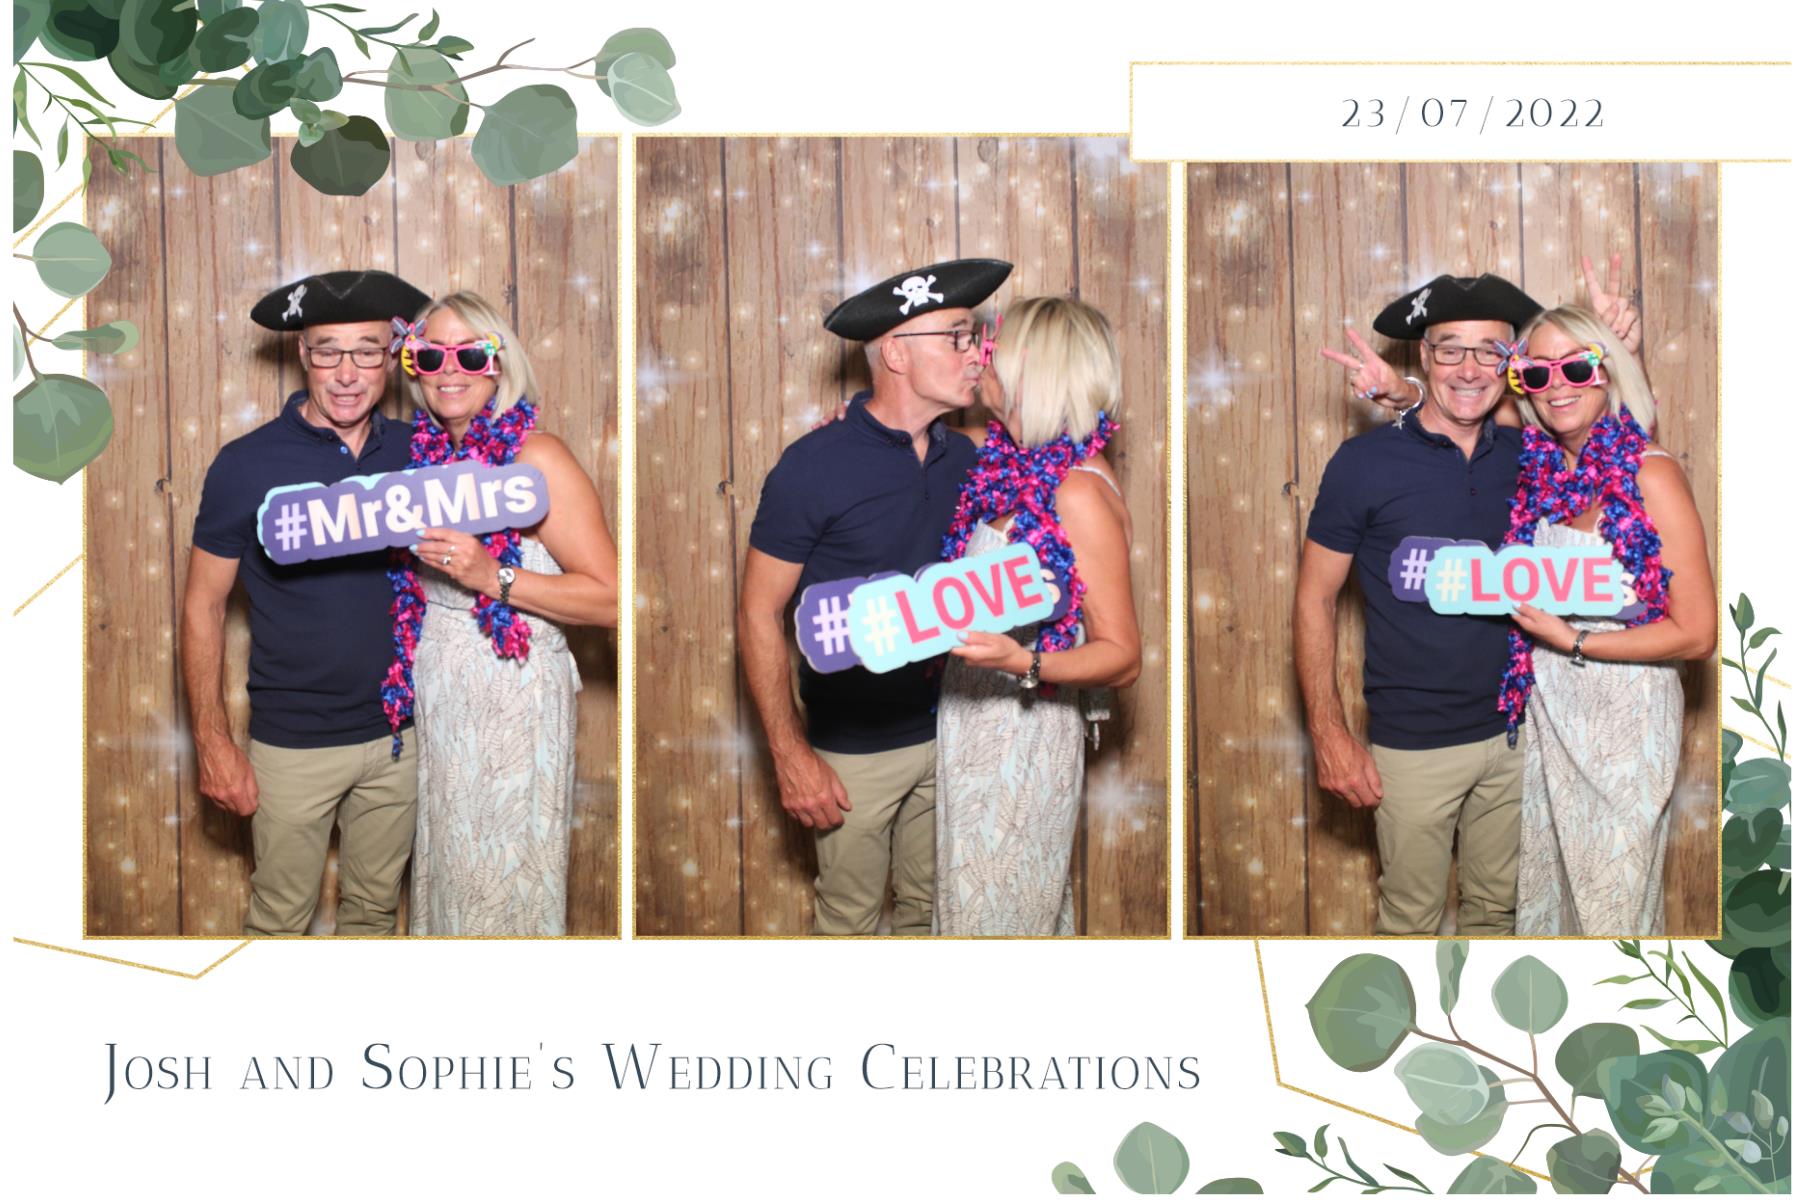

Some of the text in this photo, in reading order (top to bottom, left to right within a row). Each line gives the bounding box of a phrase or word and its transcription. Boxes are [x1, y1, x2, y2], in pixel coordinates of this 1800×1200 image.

[275, 472, 538, 552] #Mr&Mrs
[861, 555, 1044, 657] #LOVE
[1435, 556, 1614, 603] #LOVE
